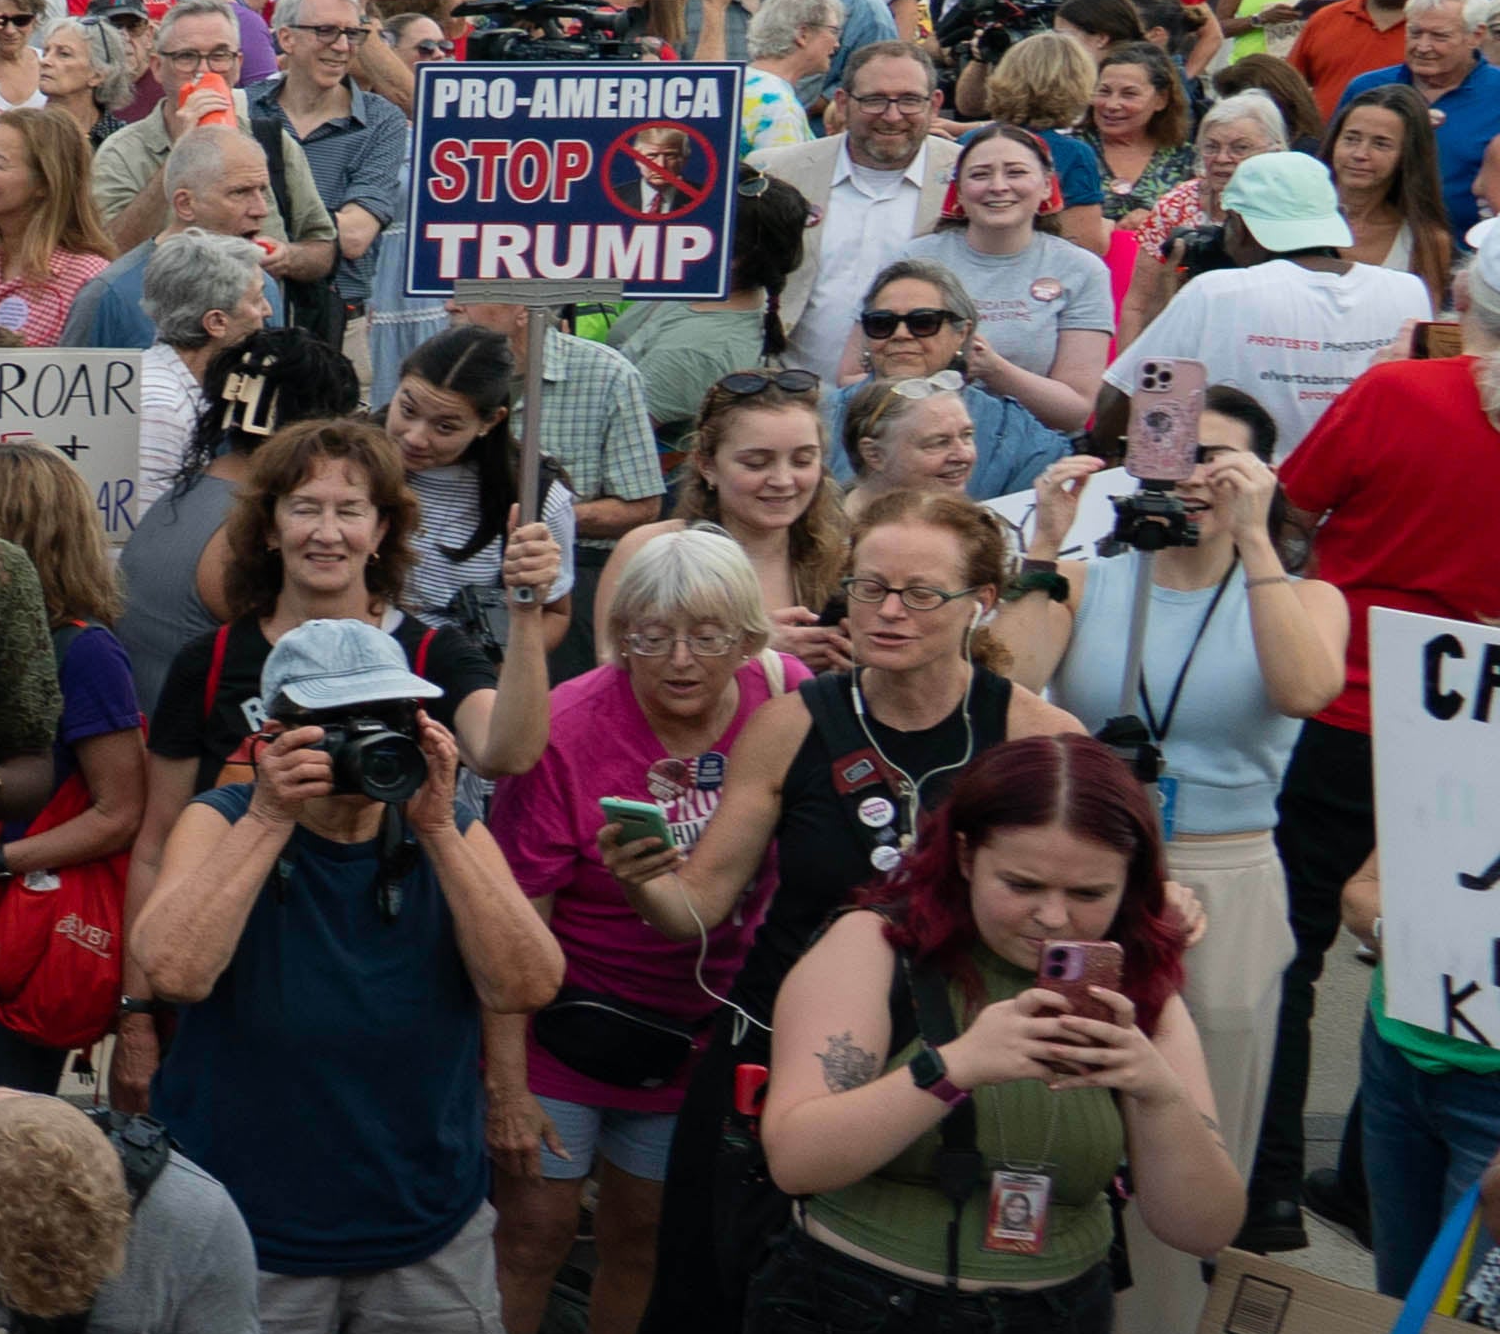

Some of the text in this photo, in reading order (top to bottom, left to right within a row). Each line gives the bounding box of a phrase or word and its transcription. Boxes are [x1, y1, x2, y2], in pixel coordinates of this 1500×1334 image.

[431, 76, 722, 120] PRO-AMERICA
[426, 137, 593, 205] STOP
[424, 221, 715, 282] TRUMP
[1246, 334, 1320, 351] PROTESTS
[95, 478, 138, 532] AR
